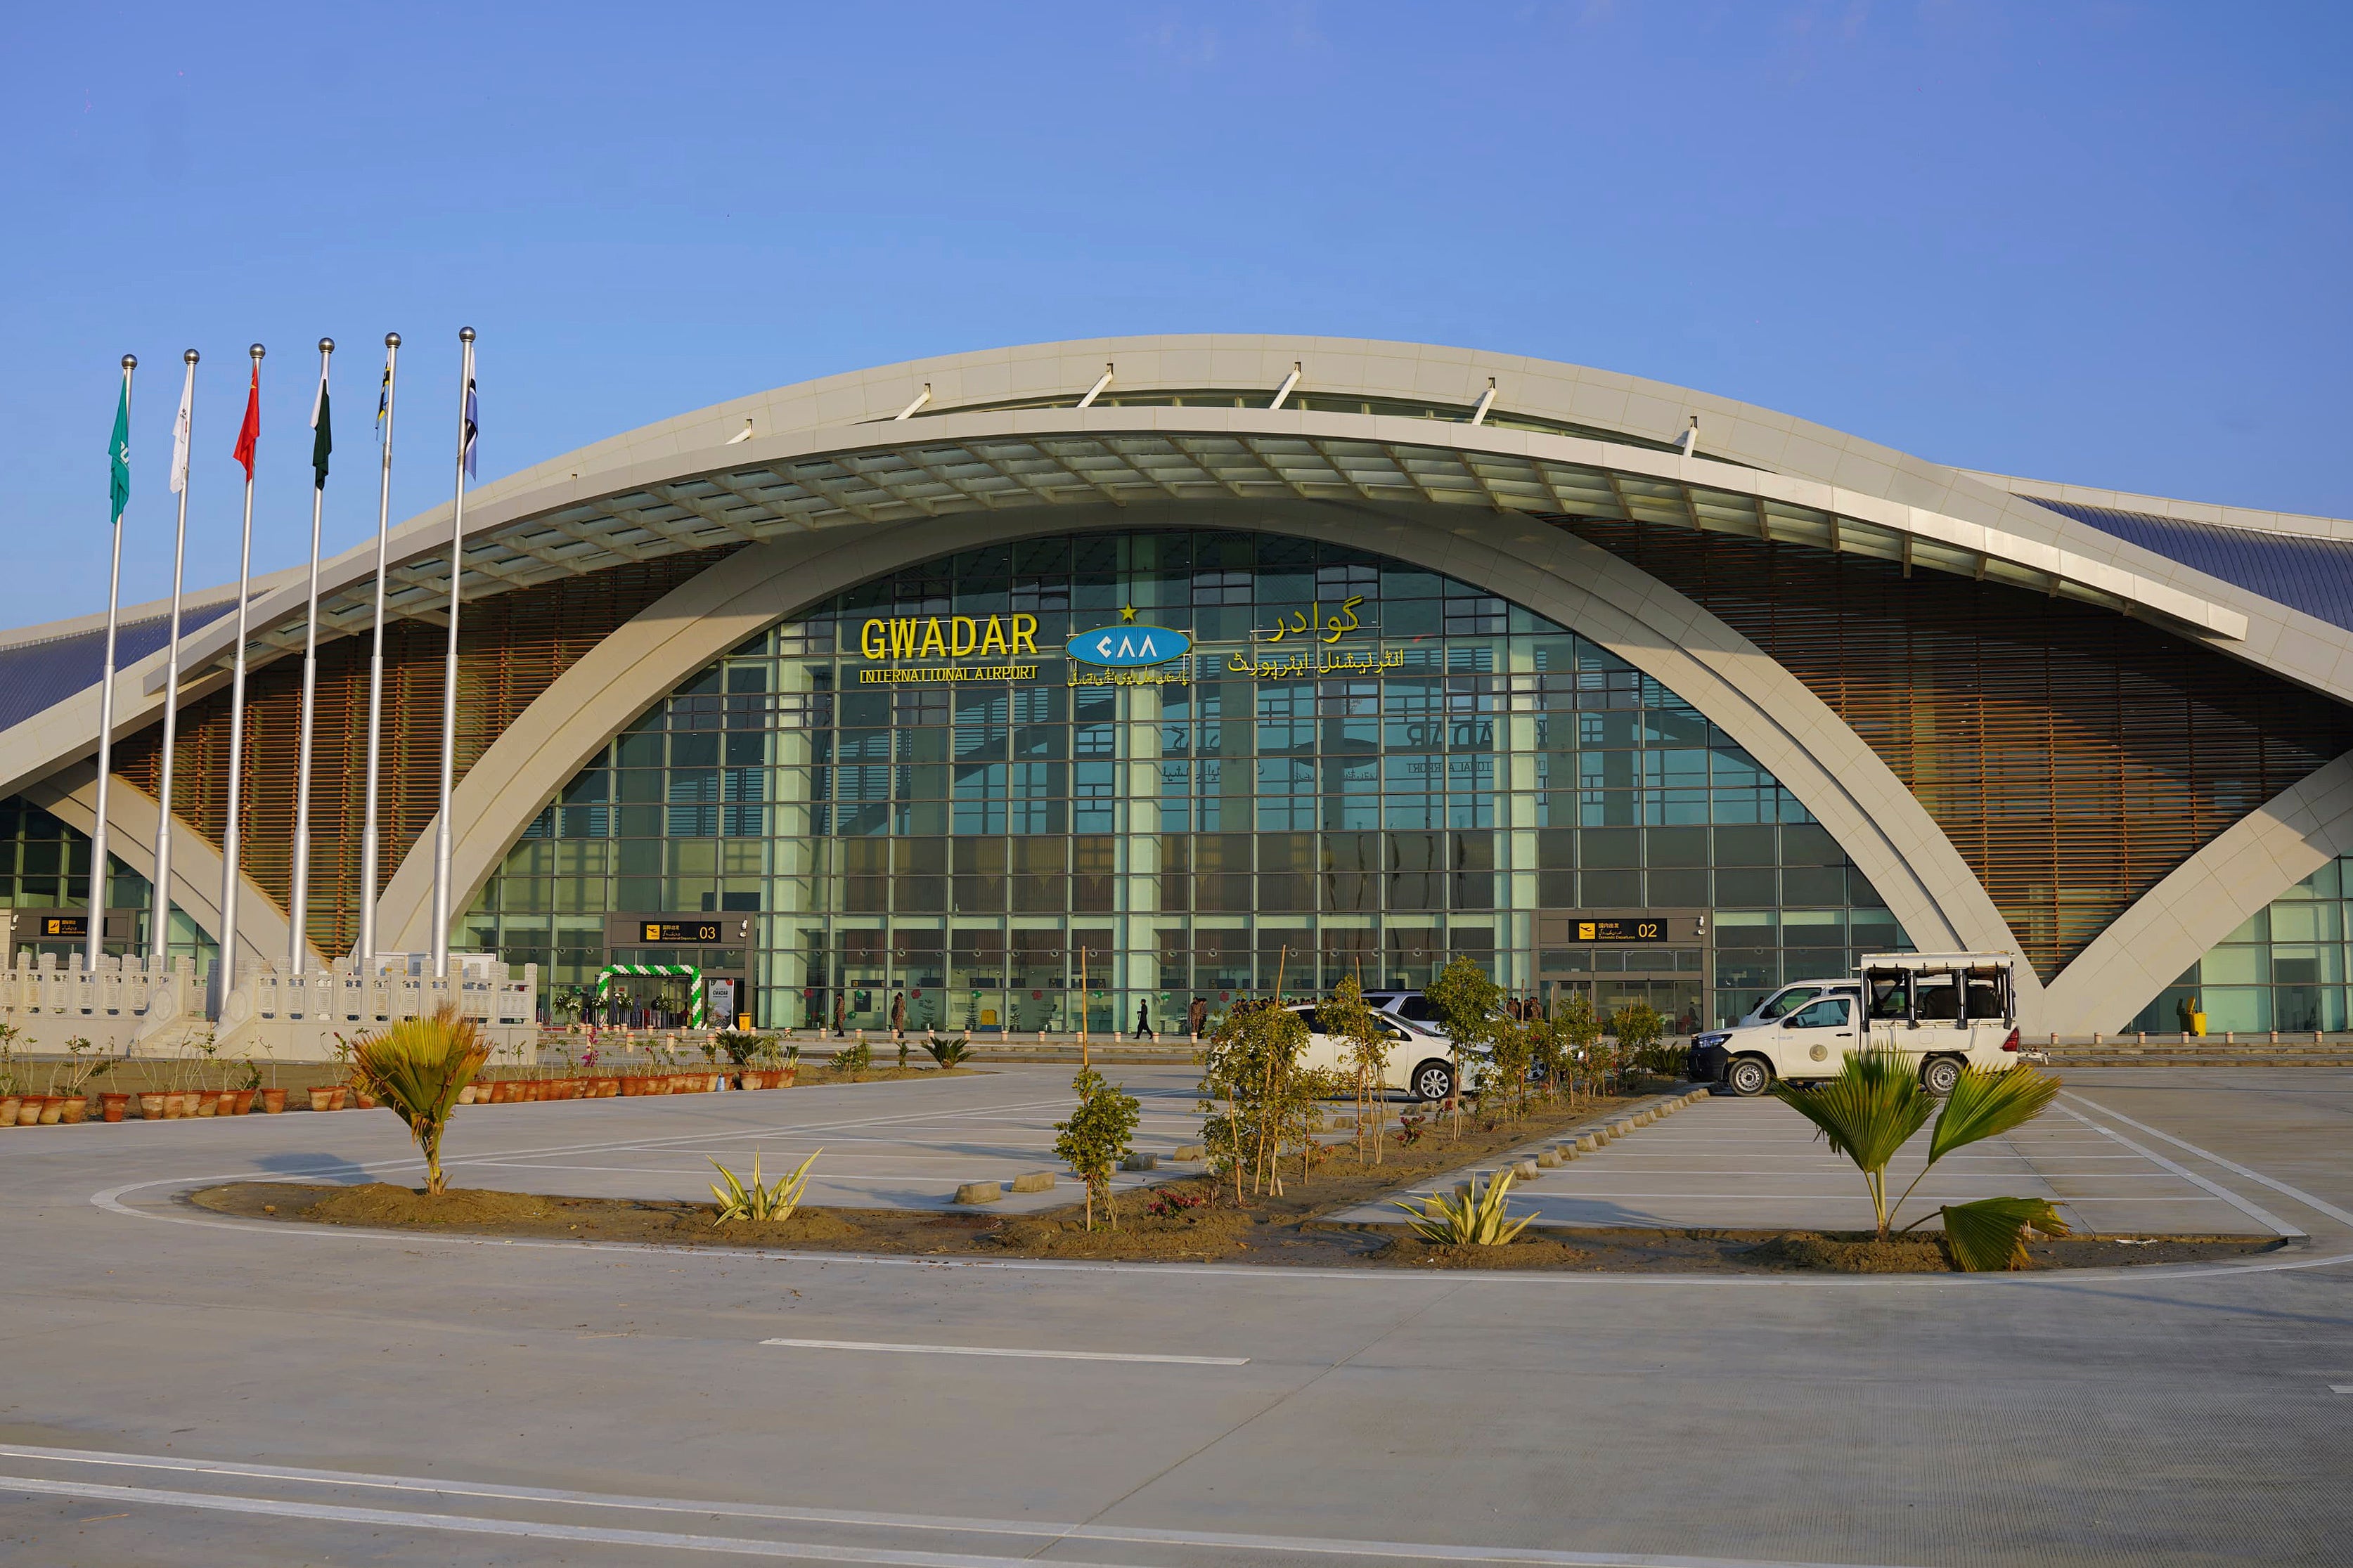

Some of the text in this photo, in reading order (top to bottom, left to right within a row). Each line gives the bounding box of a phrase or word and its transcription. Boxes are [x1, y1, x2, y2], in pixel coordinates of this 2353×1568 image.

[1266, 595, 1364, 643] گوادر
[860, 613, 1039, 660] GWADAR
[860, 665, 1038, 683] INTERNATIONAL AIRPORT
[700, 926, 716, 940] 03
[1638, 924, 1657, 938] 02
